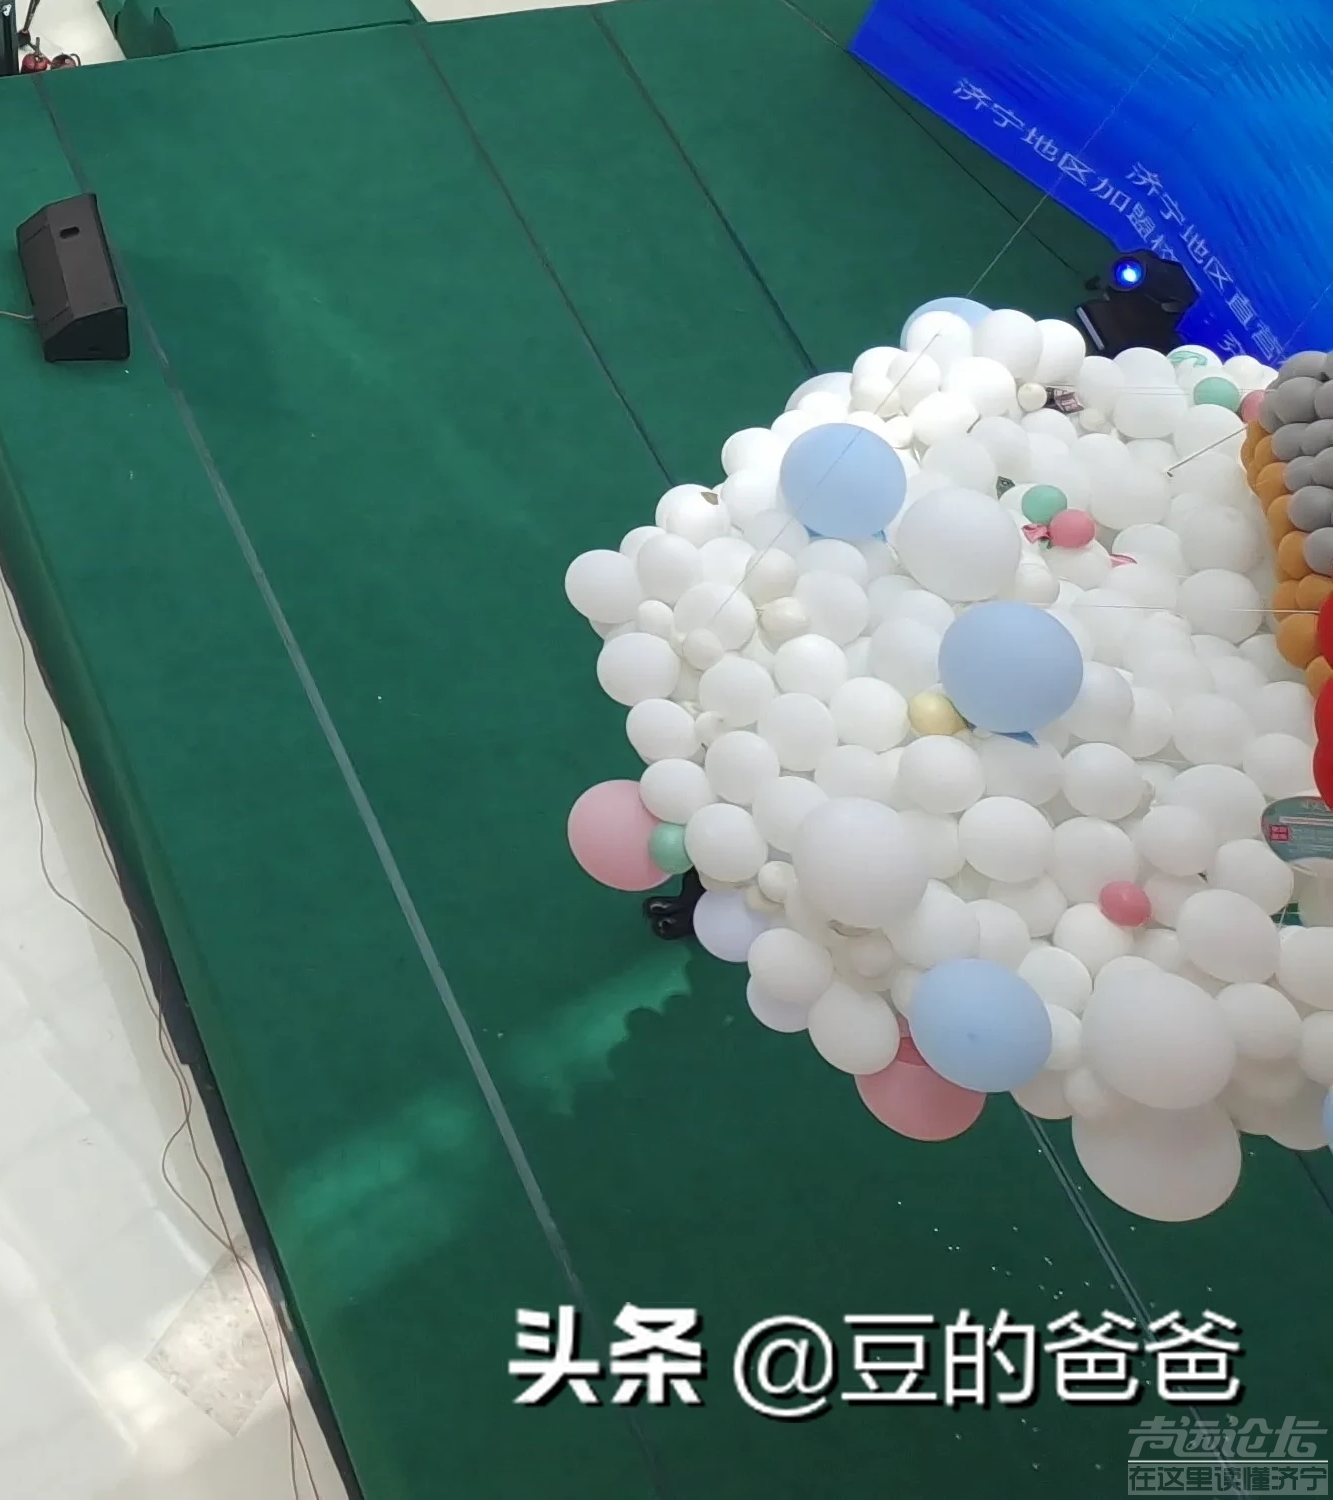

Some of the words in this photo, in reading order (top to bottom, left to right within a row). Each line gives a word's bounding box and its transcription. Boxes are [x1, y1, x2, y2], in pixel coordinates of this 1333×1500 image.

[1125, 161, 1286, 363] 济宁地区直营
